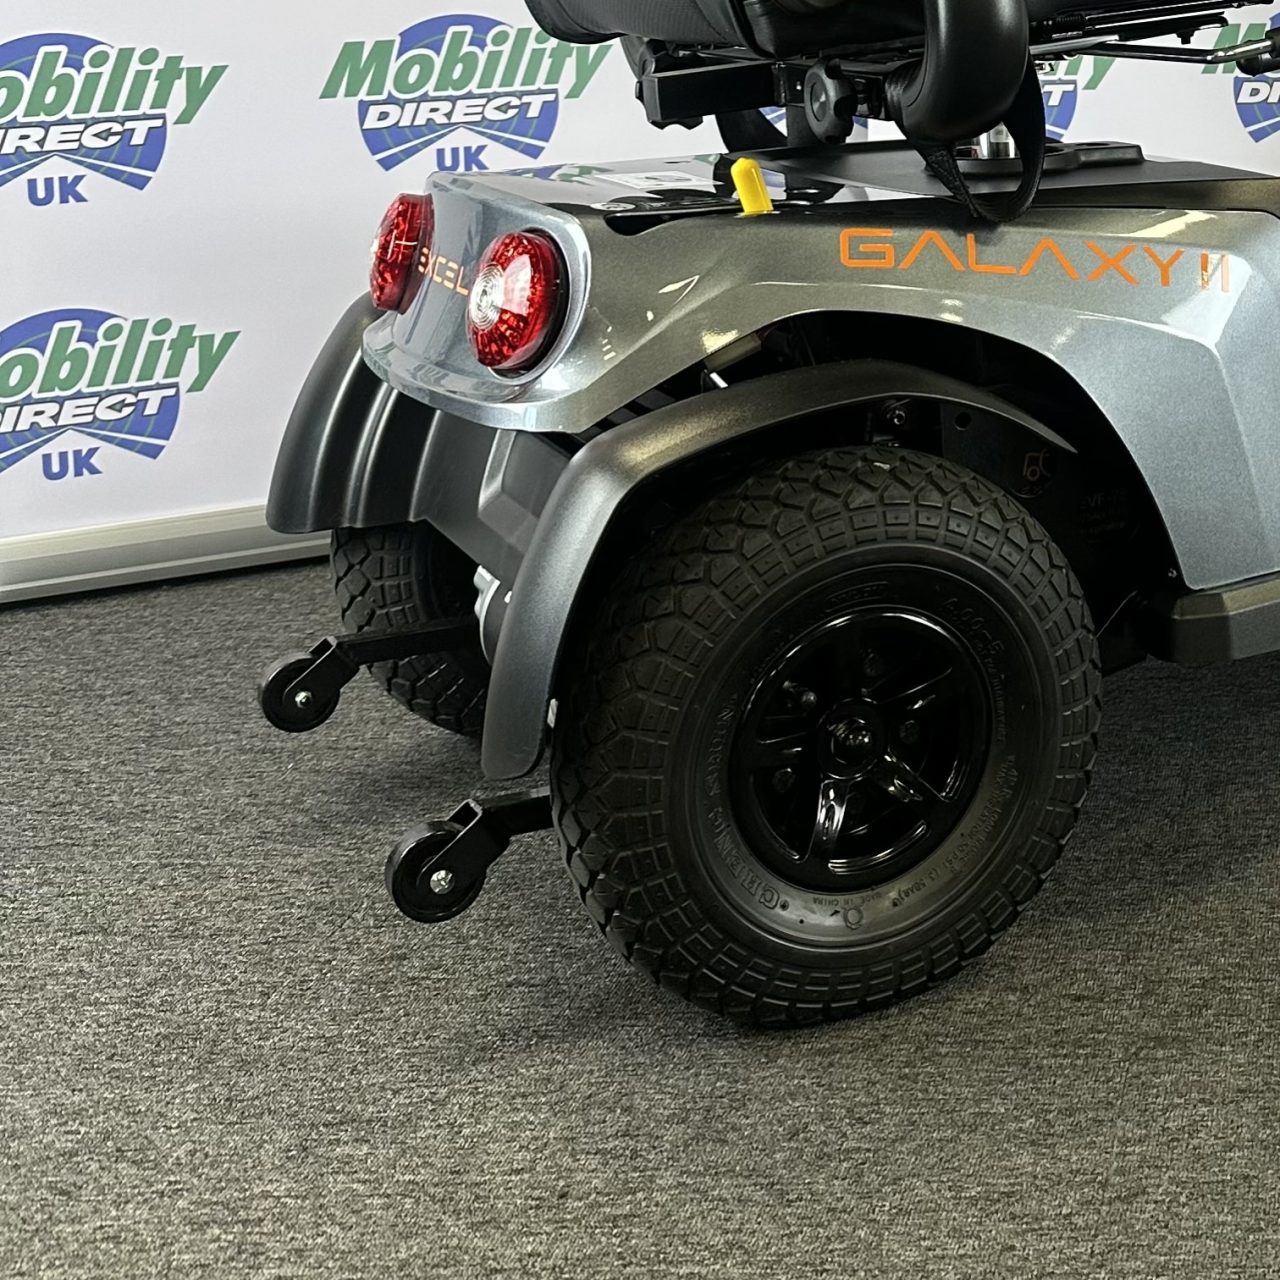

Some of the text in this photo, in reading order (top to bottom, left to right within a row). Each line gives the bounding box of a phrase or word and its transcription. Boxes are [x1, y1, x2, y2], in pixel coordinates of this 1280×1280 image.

[318, 26, 613, 99] Mobility
[362, 93, 556, 130] DIRECT
[435, 144, 490, 176] UK
[26, 174, 89, 207] UK
[838, 226, 1184, 288] GALAXY
[0, 317, 241, 398] obility
[0, 387, 177, 432] IRECT
[41, 446, 103, 481] UK
